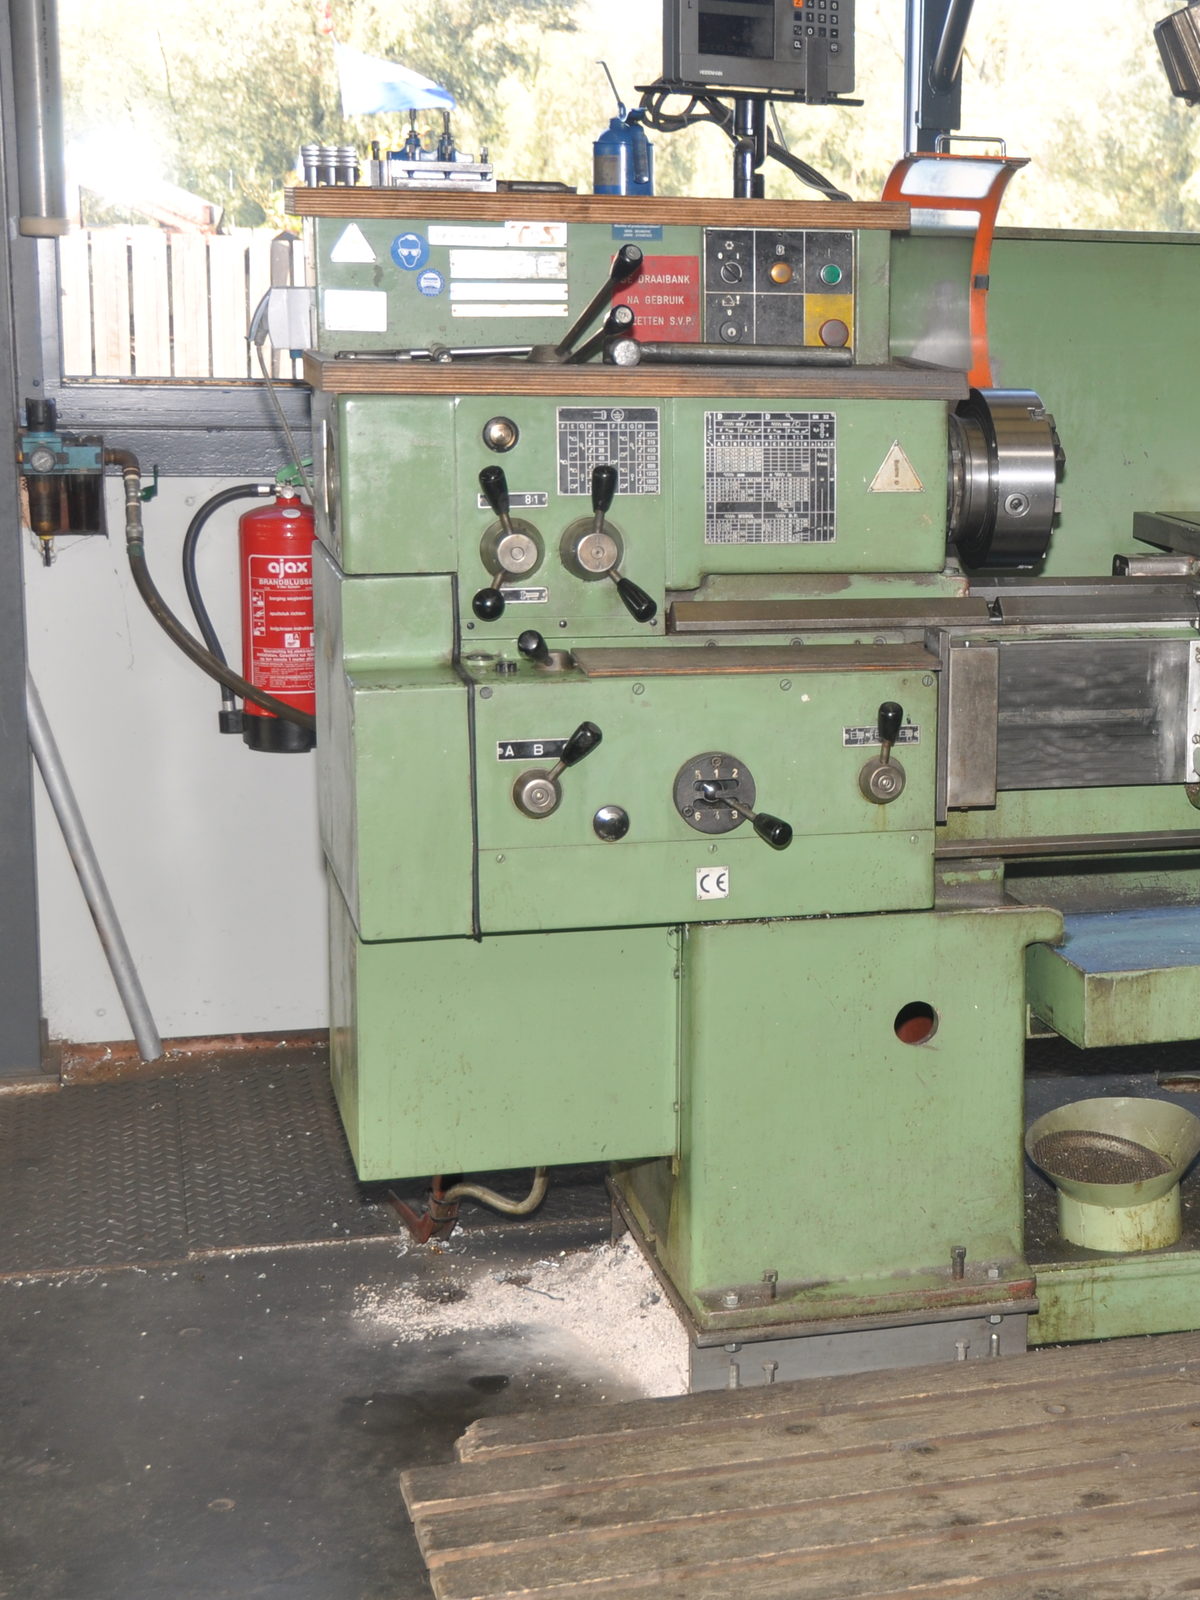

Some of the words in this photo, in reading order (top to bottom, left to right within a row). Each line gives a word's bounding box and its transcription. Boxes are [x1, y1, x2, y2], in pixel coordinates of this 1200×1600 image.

[638, 274, 690, 284] DRAAIBANK
[627, 295, 639, 305] NA
[645, 295, 685, 305] GEBRUIK
[268, 558, 308, 578] ajax
[259, 578, 313, 586] BRANDBLUSSE
[505, 745, 514, 757] A
[533, 744, 543, 756] B
[713, 769, 719, 778] 1
[731, 768, 738, 778] 2
[694, 811, 701, 821] 6
[731, 809, 738, 819] 3
